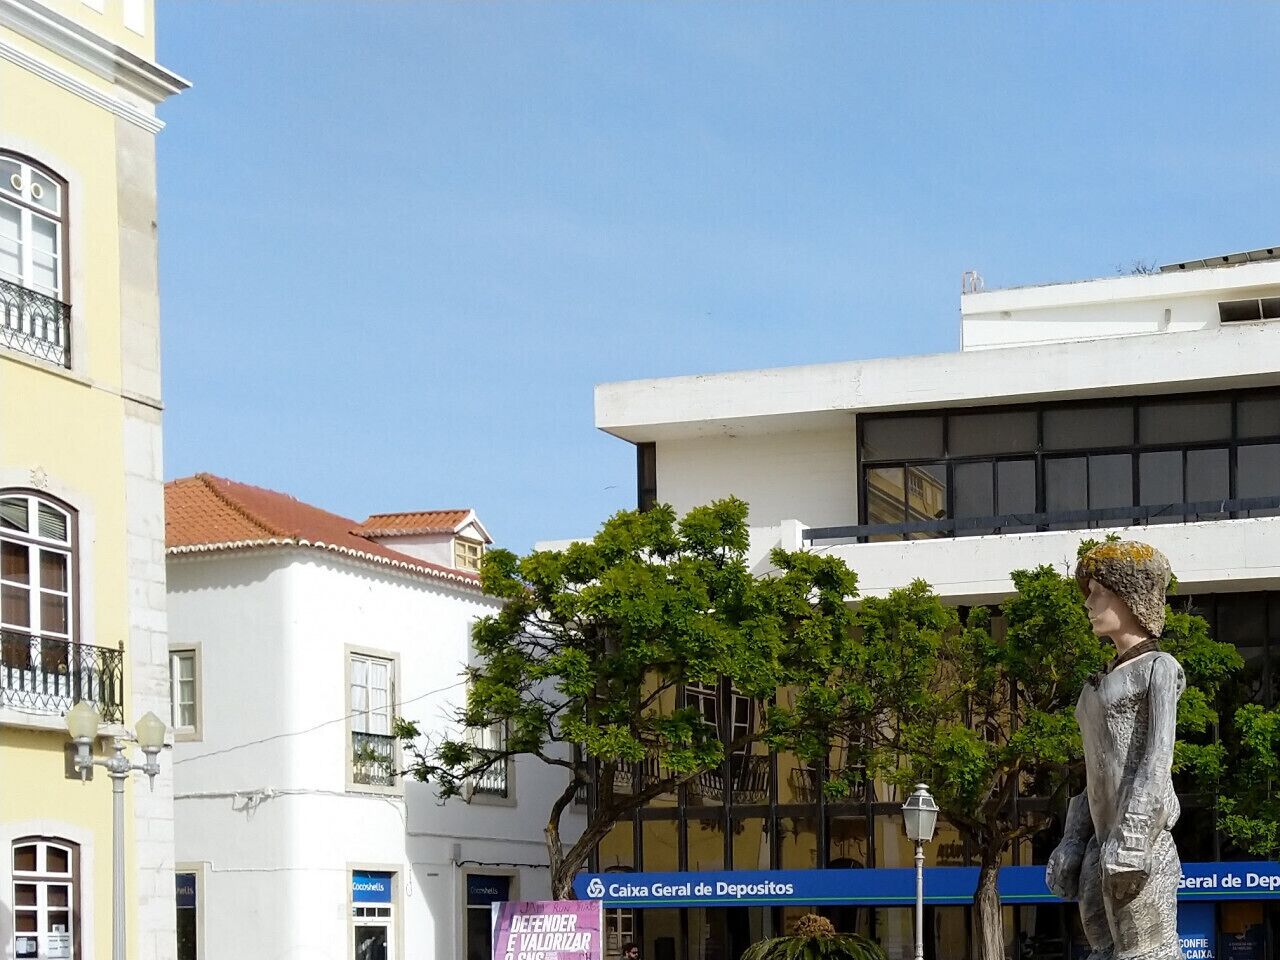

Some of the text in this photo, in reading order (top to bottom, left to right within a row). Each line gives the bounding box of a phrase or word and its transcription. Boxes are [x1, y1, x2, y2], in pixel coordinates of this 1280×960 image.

[352, 882, 385, 891] Cocoshells
[1221, 874, 1242, 888] de
[608, 881, 793, 898] Caixa Geral de Depositos
[510, 914, 578, 933] DEFENDER
[506, 932, 592, 952] E VALORIZAR
[1178, 938, 1209, 948] CONFIE
[1187, 949, 1215, 959] CAIXA.
